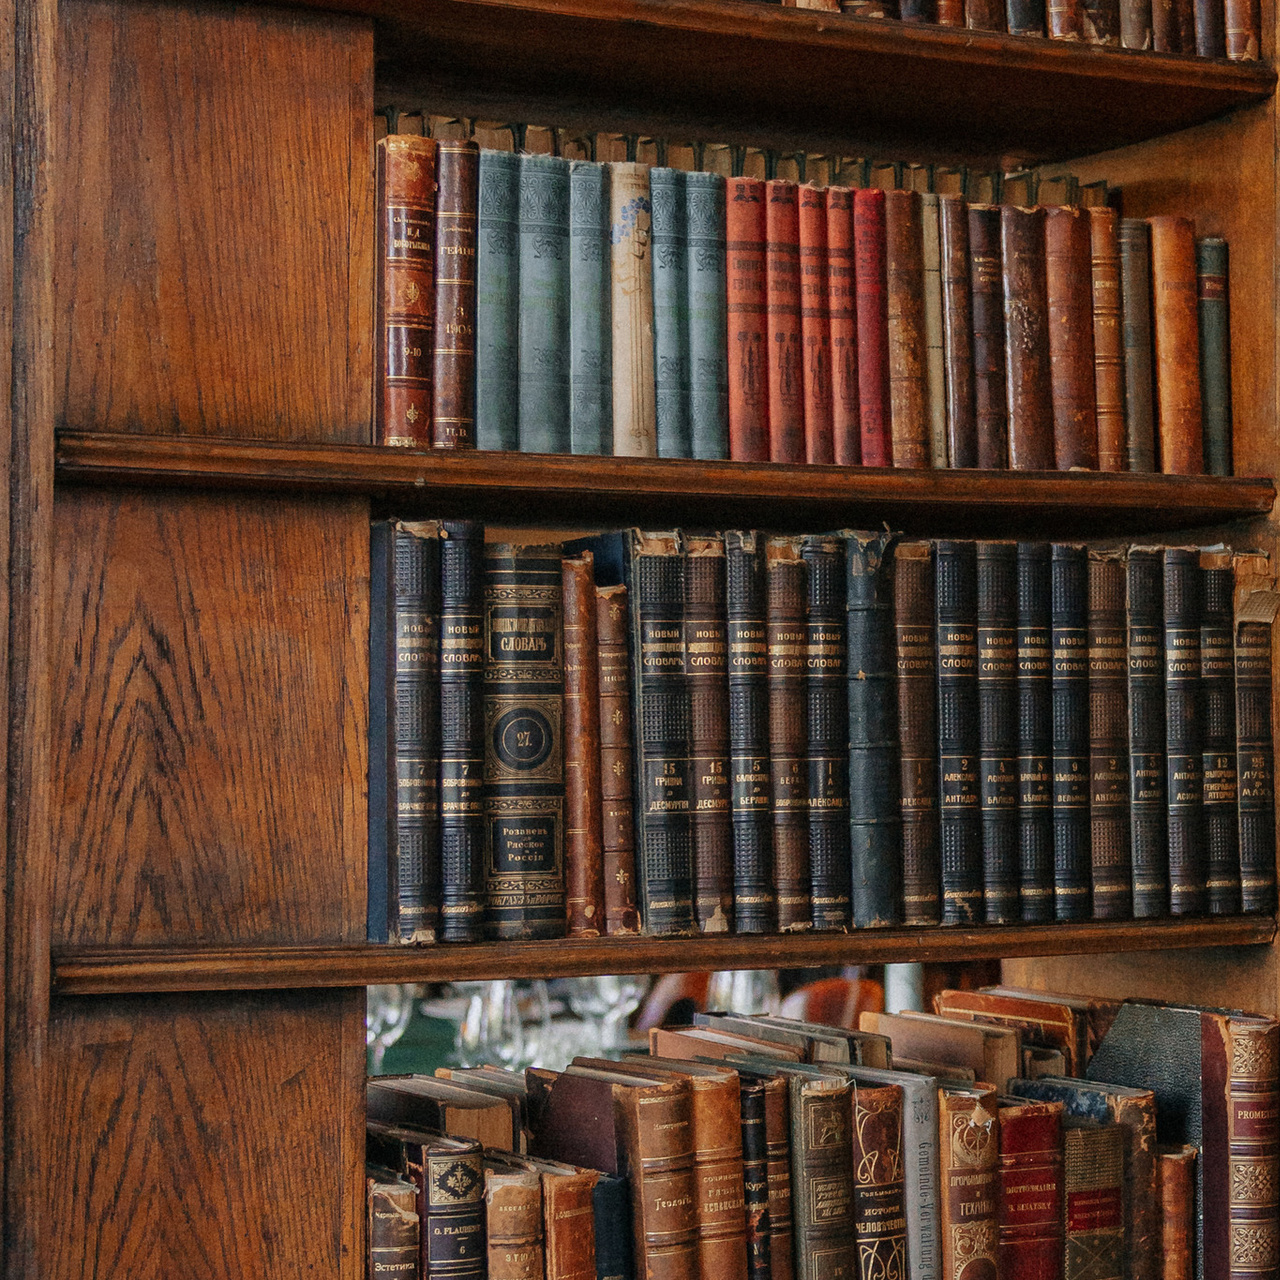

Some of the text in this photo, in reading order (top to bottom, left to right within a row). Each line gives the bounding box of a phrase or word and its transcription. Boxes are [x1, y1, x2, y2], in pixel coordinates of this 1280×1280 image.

[403, 624, 431, 634] НОВ
[649, 630, 680, 639] НОВЫЙ
[696, 630, 721, 639] НОВЫ
[736, 630, 764, 639] НОВЫ
[501, 636, 547, 652] СЛОВАРЬ
[1024, 637, 1047, 646] НОВЫ
[690, 657, 725, 666] СЛОВА
[516, 731, 533, 748] 27.
[461, 764, 470, 775] 7
[960, 759, 969, 771] 2
[808, 797, 844, 808] АЛЕКСАНД
[507, 853, 545, 863] Россія
[1006, 1183, 1056, 1195] DICTIONNAIRE
[653, 1195, 692, 1211] Теологі
[917, 1141, 936, 1270] Gemeinde-Verwaltung
[433, 1223, 482, 1236] G. FLAUBERT
[459, 1245, 466, 1255] 6
[505, 1251, 537, 1263] ЭТЮД
[374, 1261, 416, 1272] Эстетика
